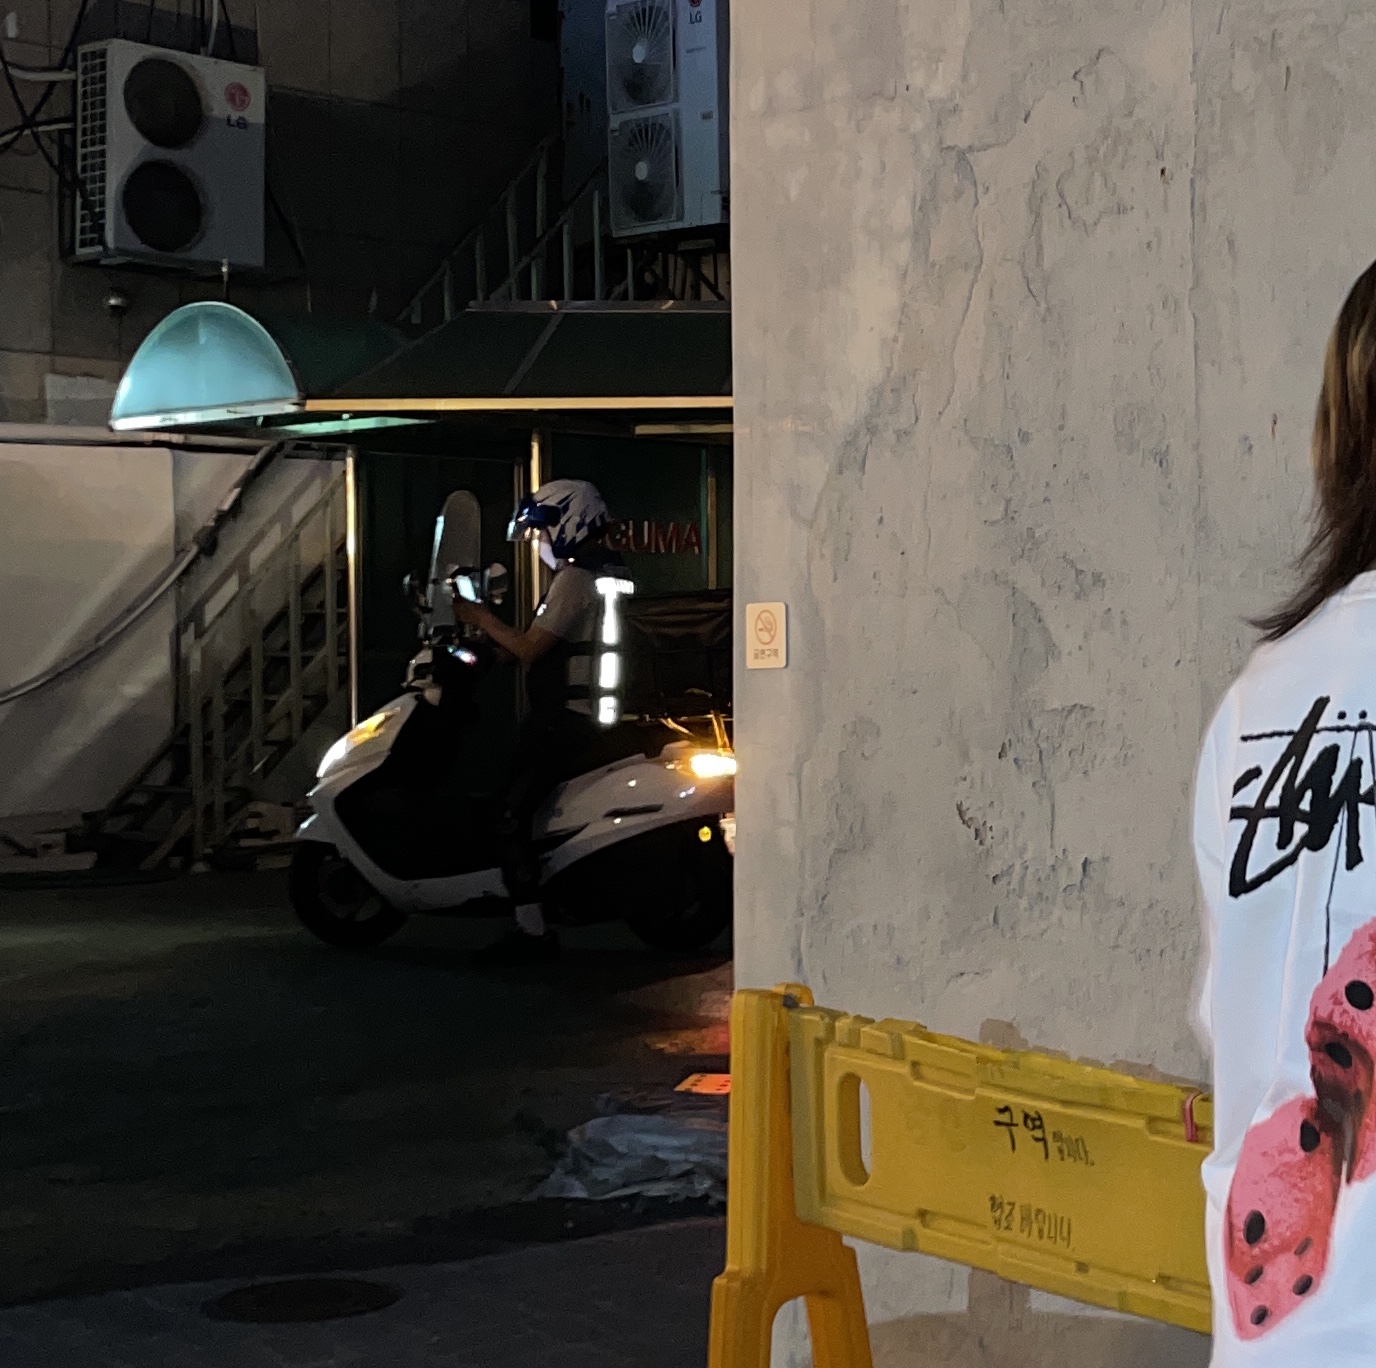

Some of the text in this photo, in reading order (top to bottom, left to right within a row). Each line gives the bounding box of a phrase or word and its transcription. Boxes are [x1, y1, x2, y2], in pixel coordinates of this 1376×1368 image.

[689, 10, 702, 24] LG
[226, 113, 248, 129] LG
[598, 518, 702, 553] GUMA
